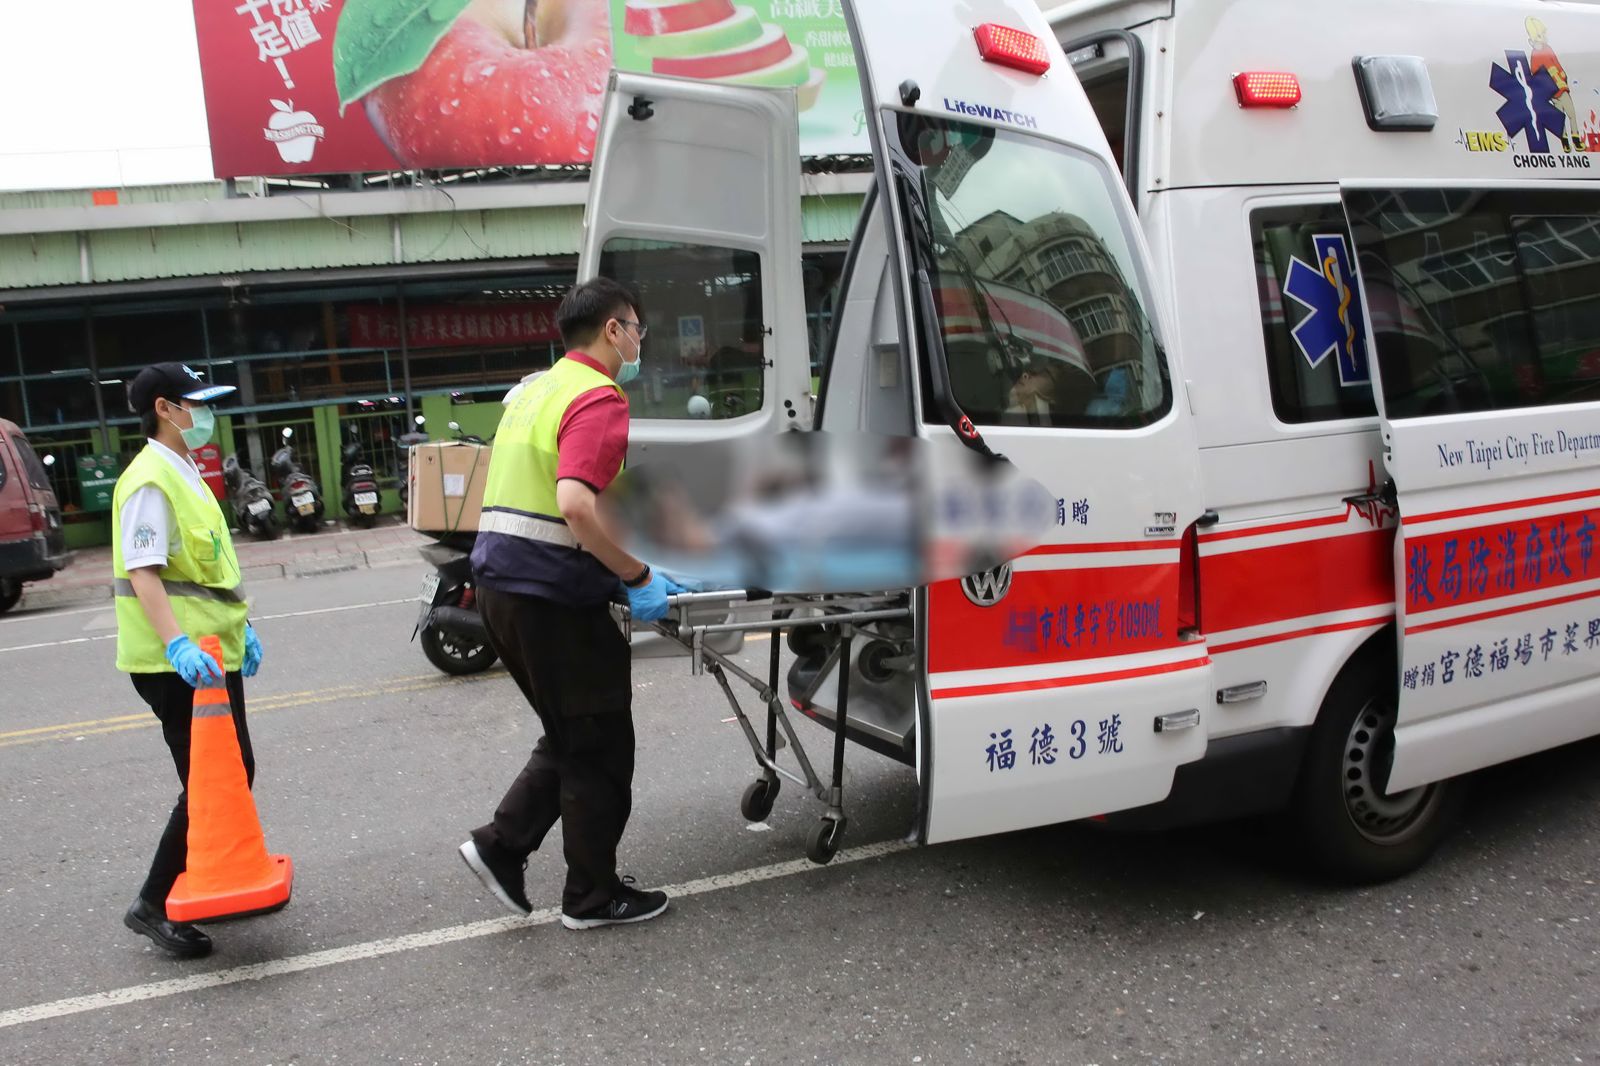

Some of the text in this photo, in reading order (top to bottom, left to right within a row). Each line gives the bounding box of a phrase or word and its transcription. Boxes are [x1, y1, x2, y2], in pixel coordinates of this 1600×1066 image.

[943, 98, 1038, 129] LifeWATCH
[1465, 131, 1508, 152] EMS
[1513, 155, 1590, 168] CHONG YANG
[1437, 443, 1463, 468] New
[1466, 439, 1502, 470] Taipei
[1505, 435, 1529, 464] City
[1531, 432, 1554, 456] Fire
[985, 713, 1124, 772] 福德3號
